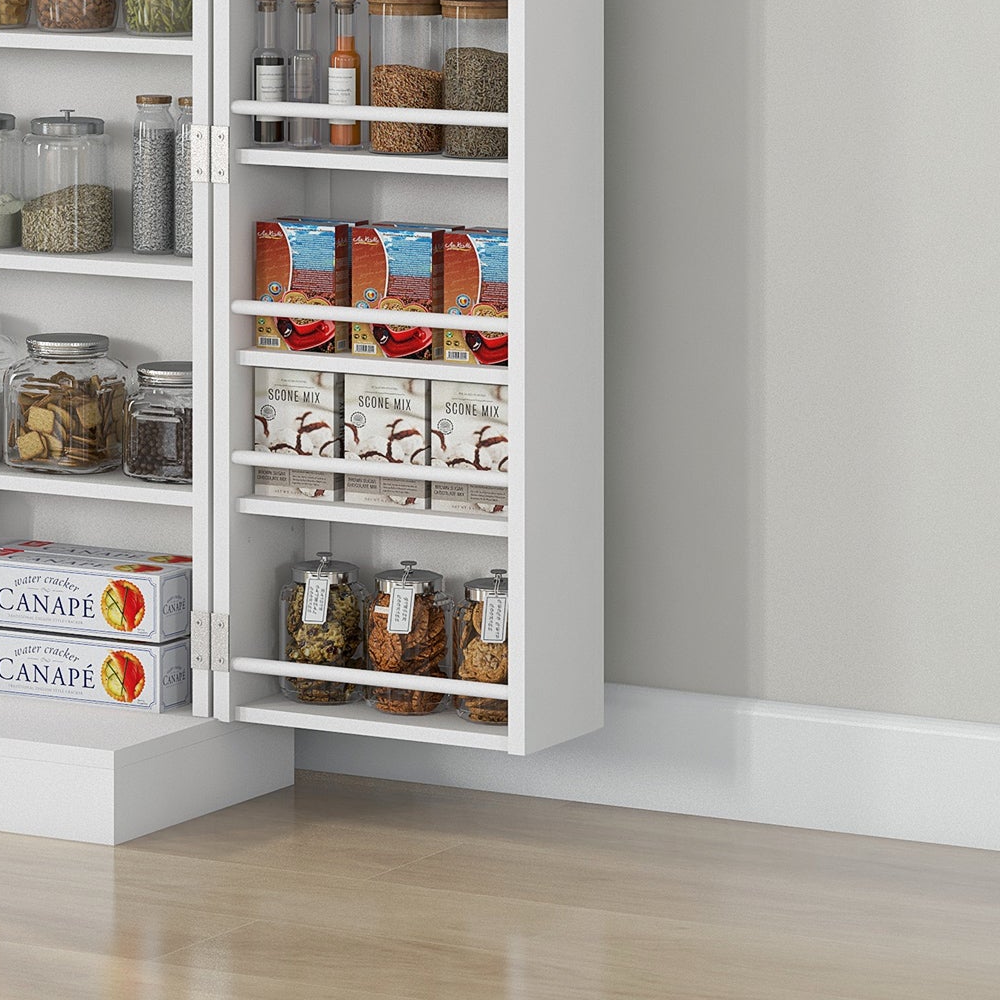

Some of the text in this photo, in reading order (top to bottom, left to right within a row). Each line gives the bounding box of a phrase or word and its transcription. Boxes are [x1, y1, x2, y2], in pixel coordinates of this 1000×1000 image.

[268, 388, 320, 403] SCONE MIX
[358, 395, 411, 411] SCONE MIX
[445, 401, 499, 418] SCONE MIX
[14, 575, 80, 592] water cracker
[14, 645, 80, 662] water cracker
